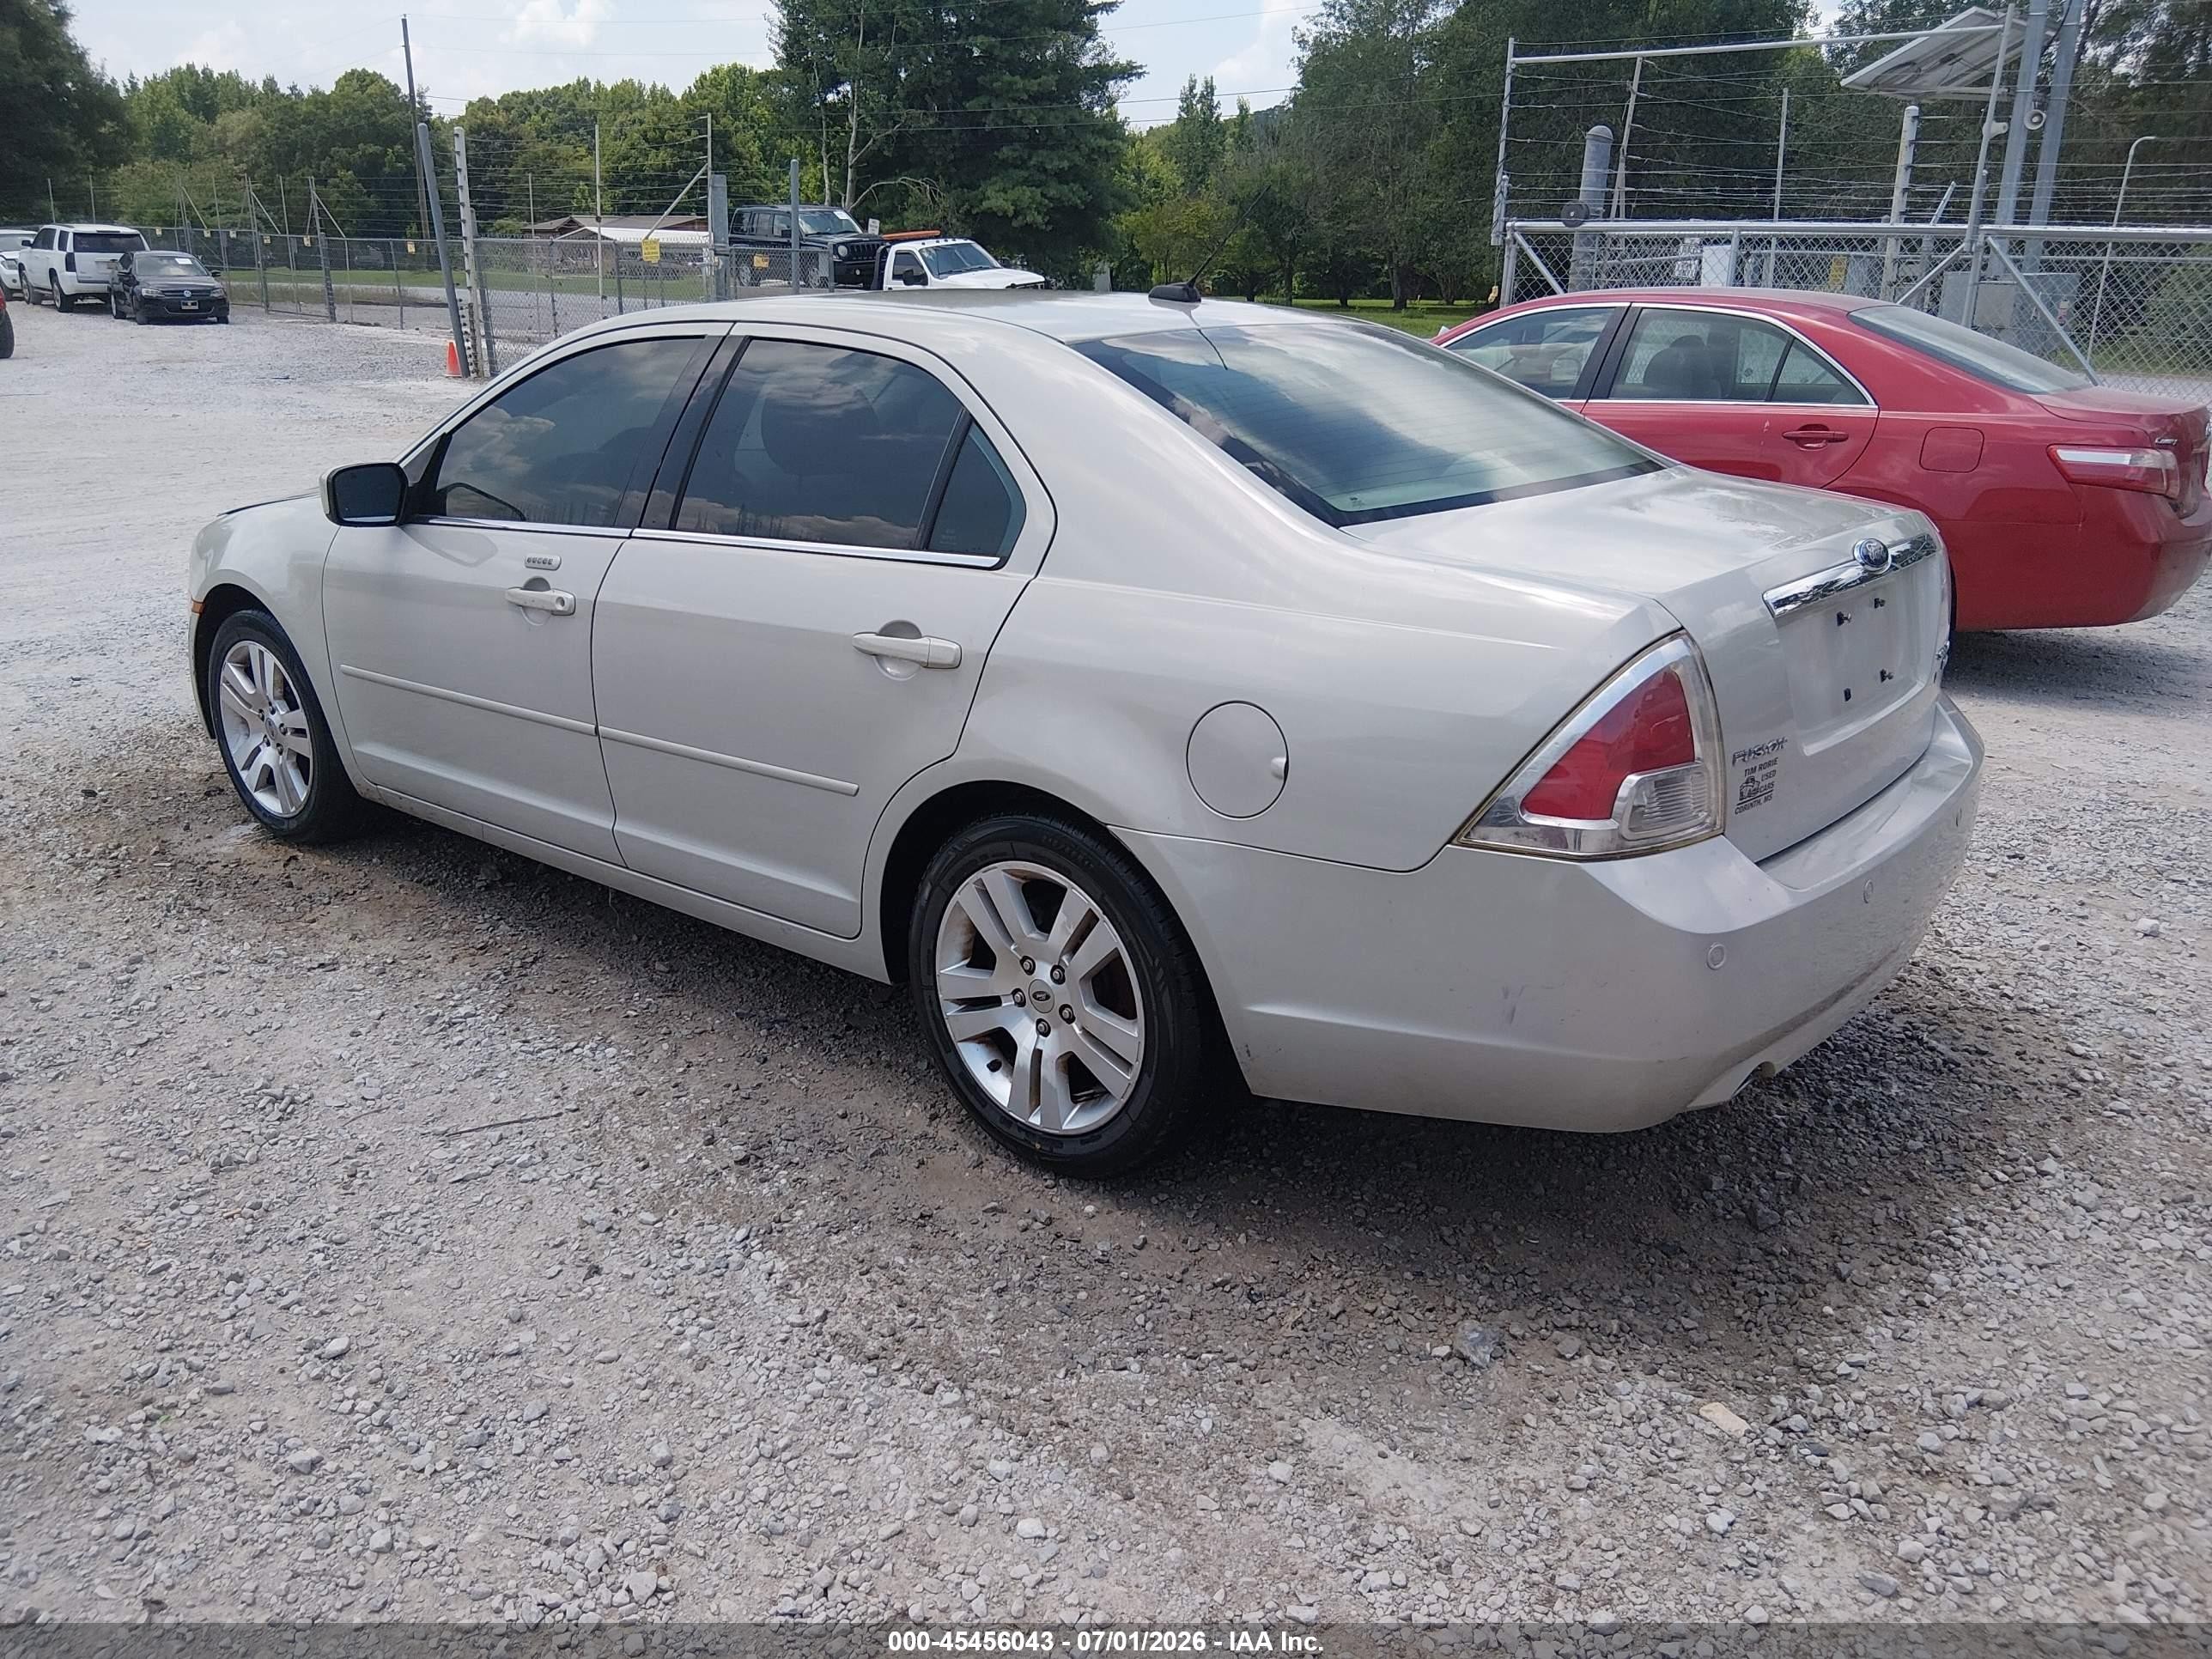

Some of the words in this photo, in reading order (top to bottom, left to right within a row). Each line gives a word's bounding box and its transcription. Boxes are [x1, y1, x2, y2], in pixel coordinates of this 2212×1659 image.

[1744, 765, 1758, 777] TIM
[1758, 757, 1778, 771] RORIE
[1761, 769, 1776, 781] USED
[1759, 781, 1774, 793] CARS
[1764, 793, 1772, 803] MS
